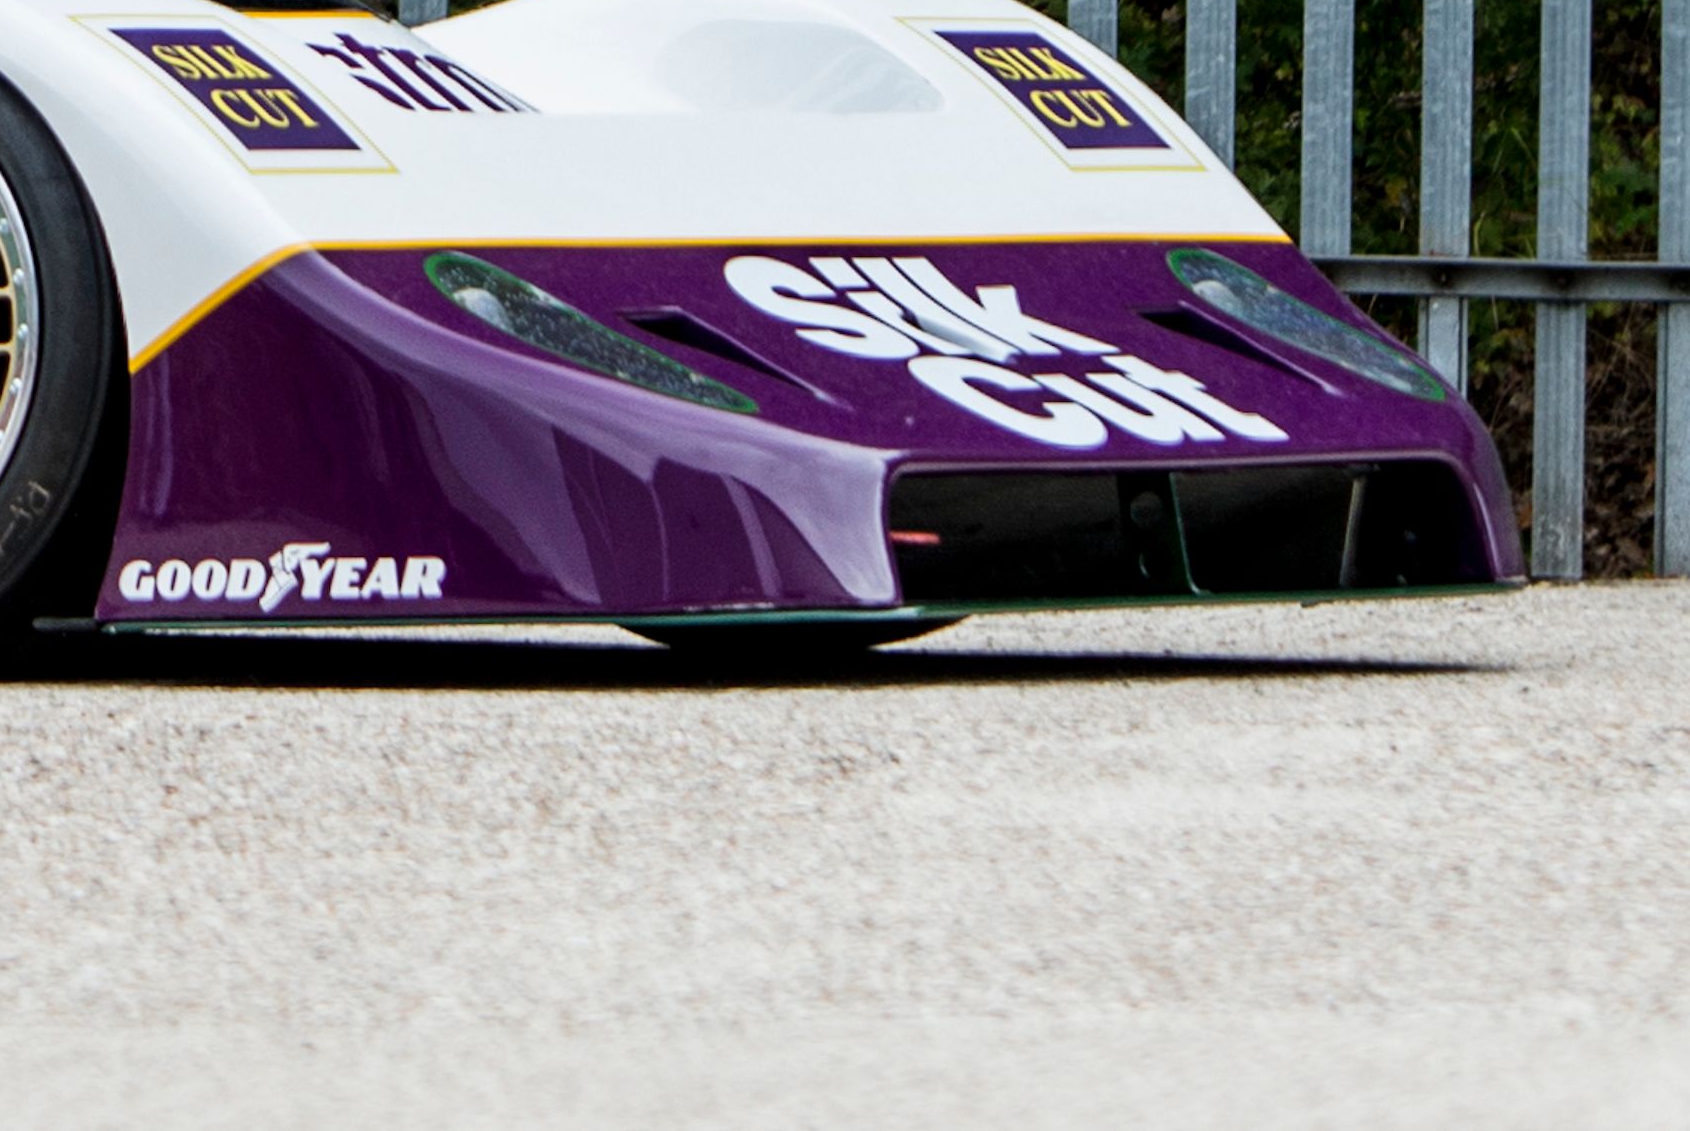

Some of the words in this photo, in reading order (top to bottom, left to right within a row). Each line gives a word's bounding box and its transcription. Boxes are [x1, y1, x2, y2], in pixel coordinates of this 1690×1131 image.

[152, 45, 273, 80] SILK
[973, 47, 1087, 81] SILK
[210, 88, 319, 128] CUT
[1029, 89, 1133, 128] CUT
[723, 255, 1120, 364] Silk
[908, 355, 1290, 449] Cut
